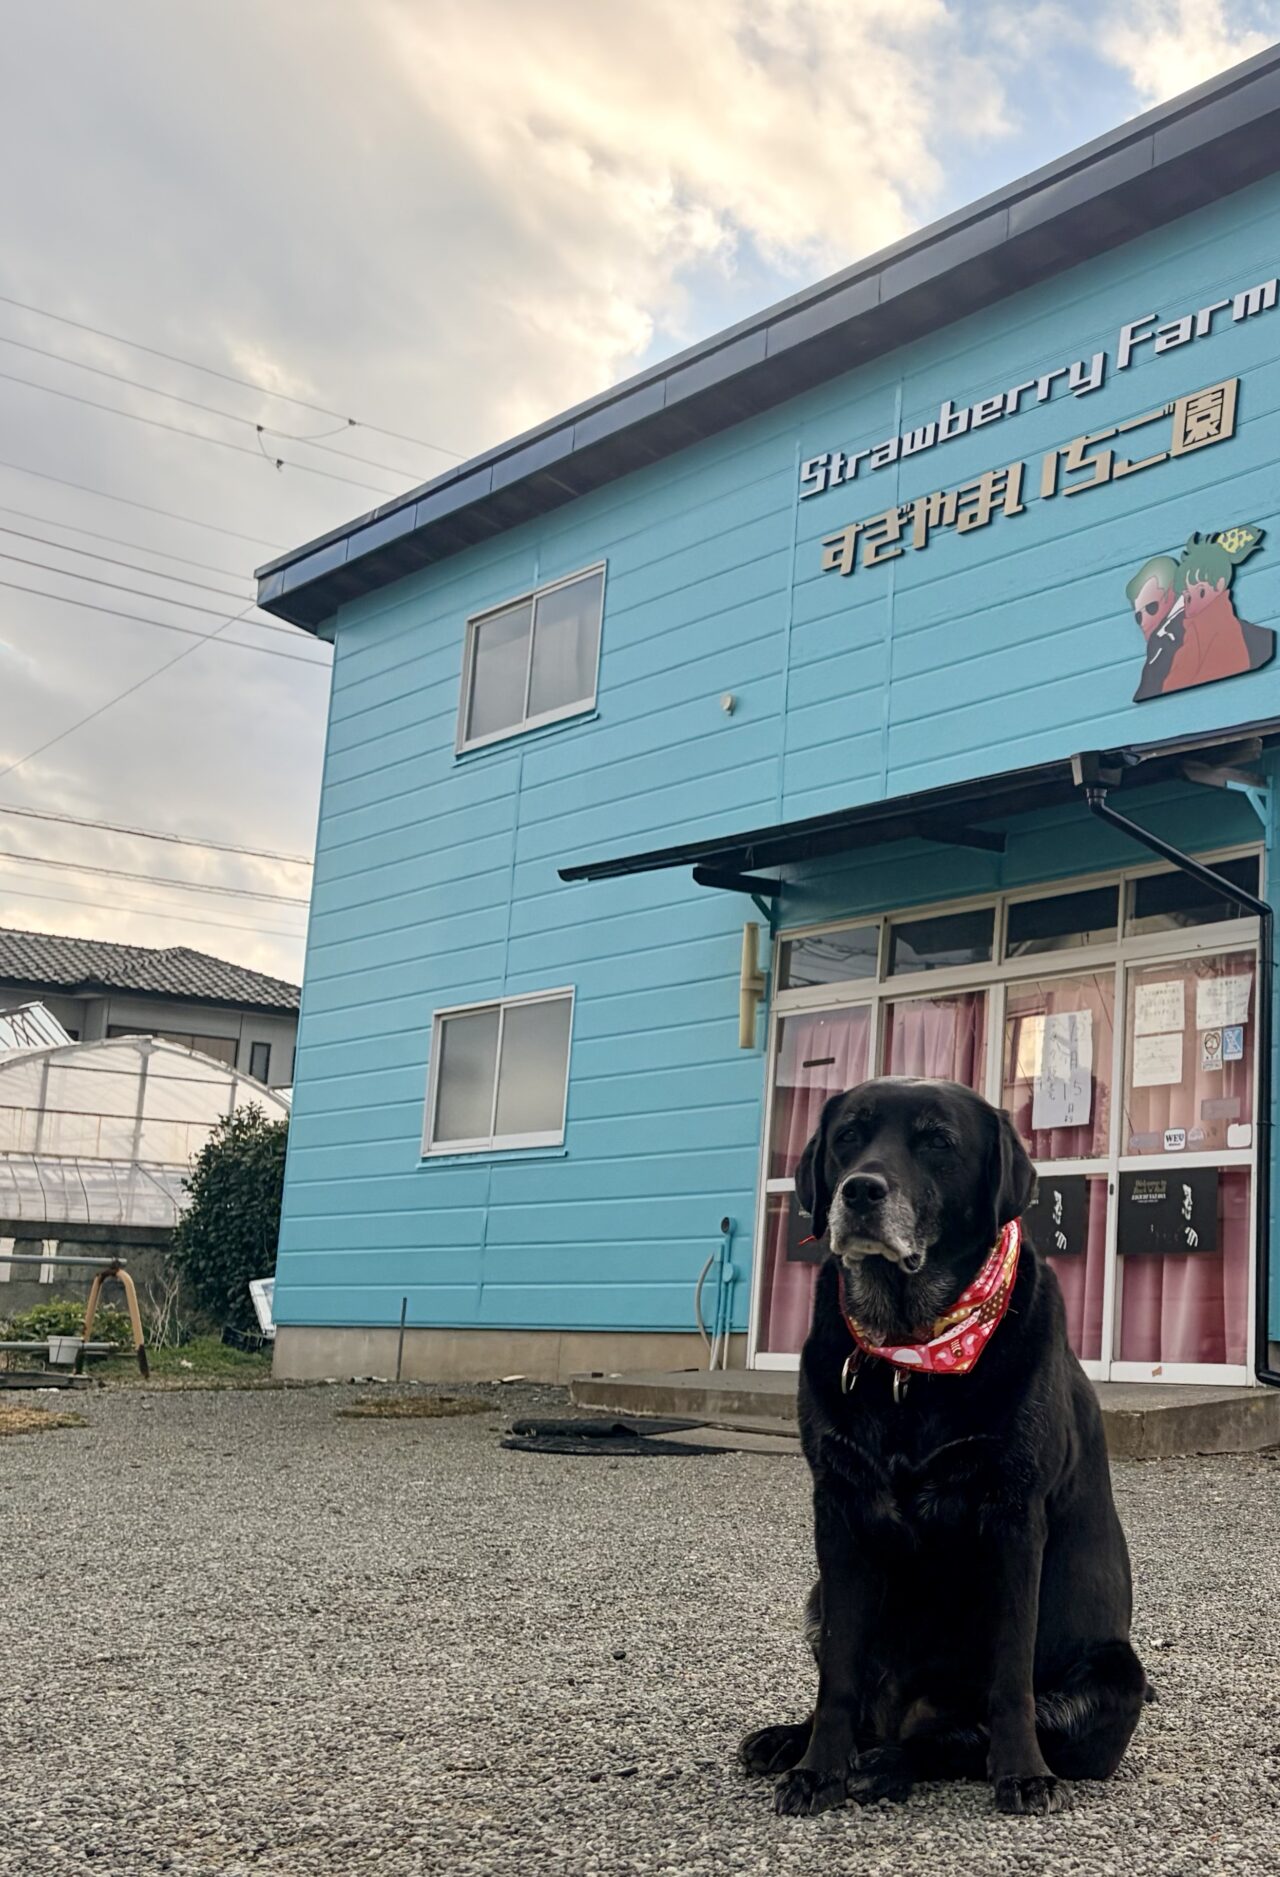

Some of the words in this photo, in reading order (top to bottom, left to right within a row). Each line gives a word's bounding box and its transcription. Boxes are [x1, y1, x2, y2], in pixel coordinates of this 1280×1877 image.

[799, 351, 1106, 499] Strawberry
[1117, 278, 1280, 369] Farm
[822, 377, 1240, 576] すぎやまいちご園
